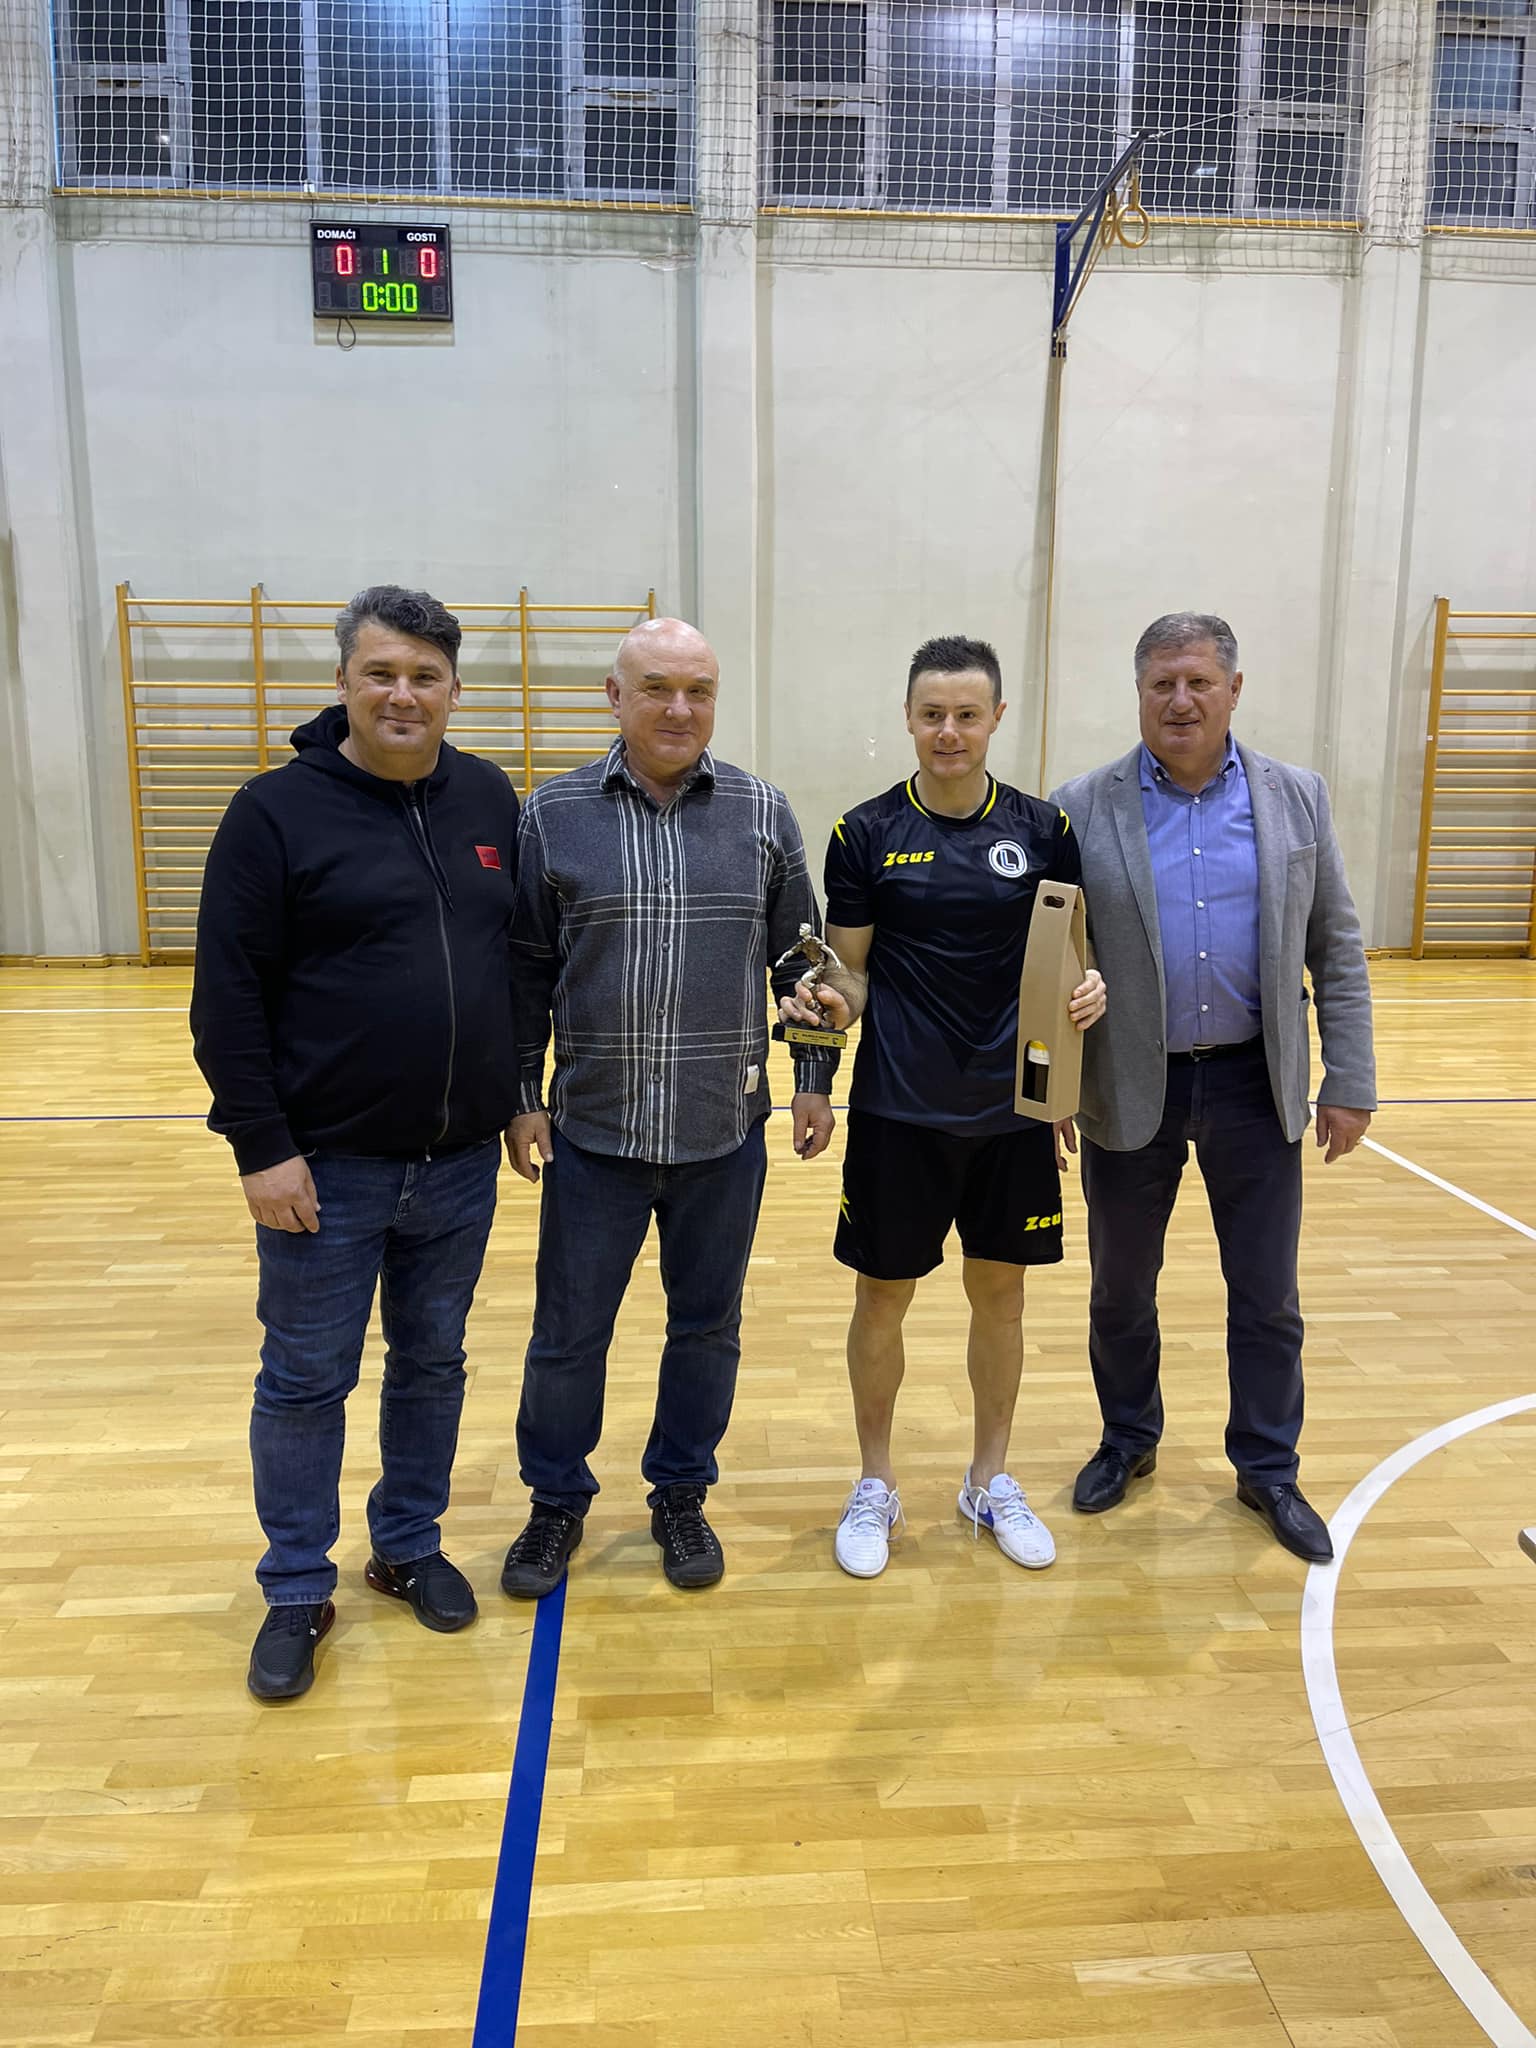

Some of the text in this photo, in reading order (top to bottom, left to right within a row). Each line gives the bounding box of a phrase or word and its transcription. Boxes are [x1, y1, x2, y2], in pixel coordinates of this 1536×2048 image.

[316, 228, 356, 240] DOMAĆI
[406, 232, 437, 242] GOSTI
[336, 245, 353, 275] 0
[382, 248, 389, 275] 1
[420, 247, 437, 278] 0
[362, 282, 418, 312] 0:00
[882, 850, 935, 867] Zeus
[1023, 1212, 1061, 1231] Zeu
